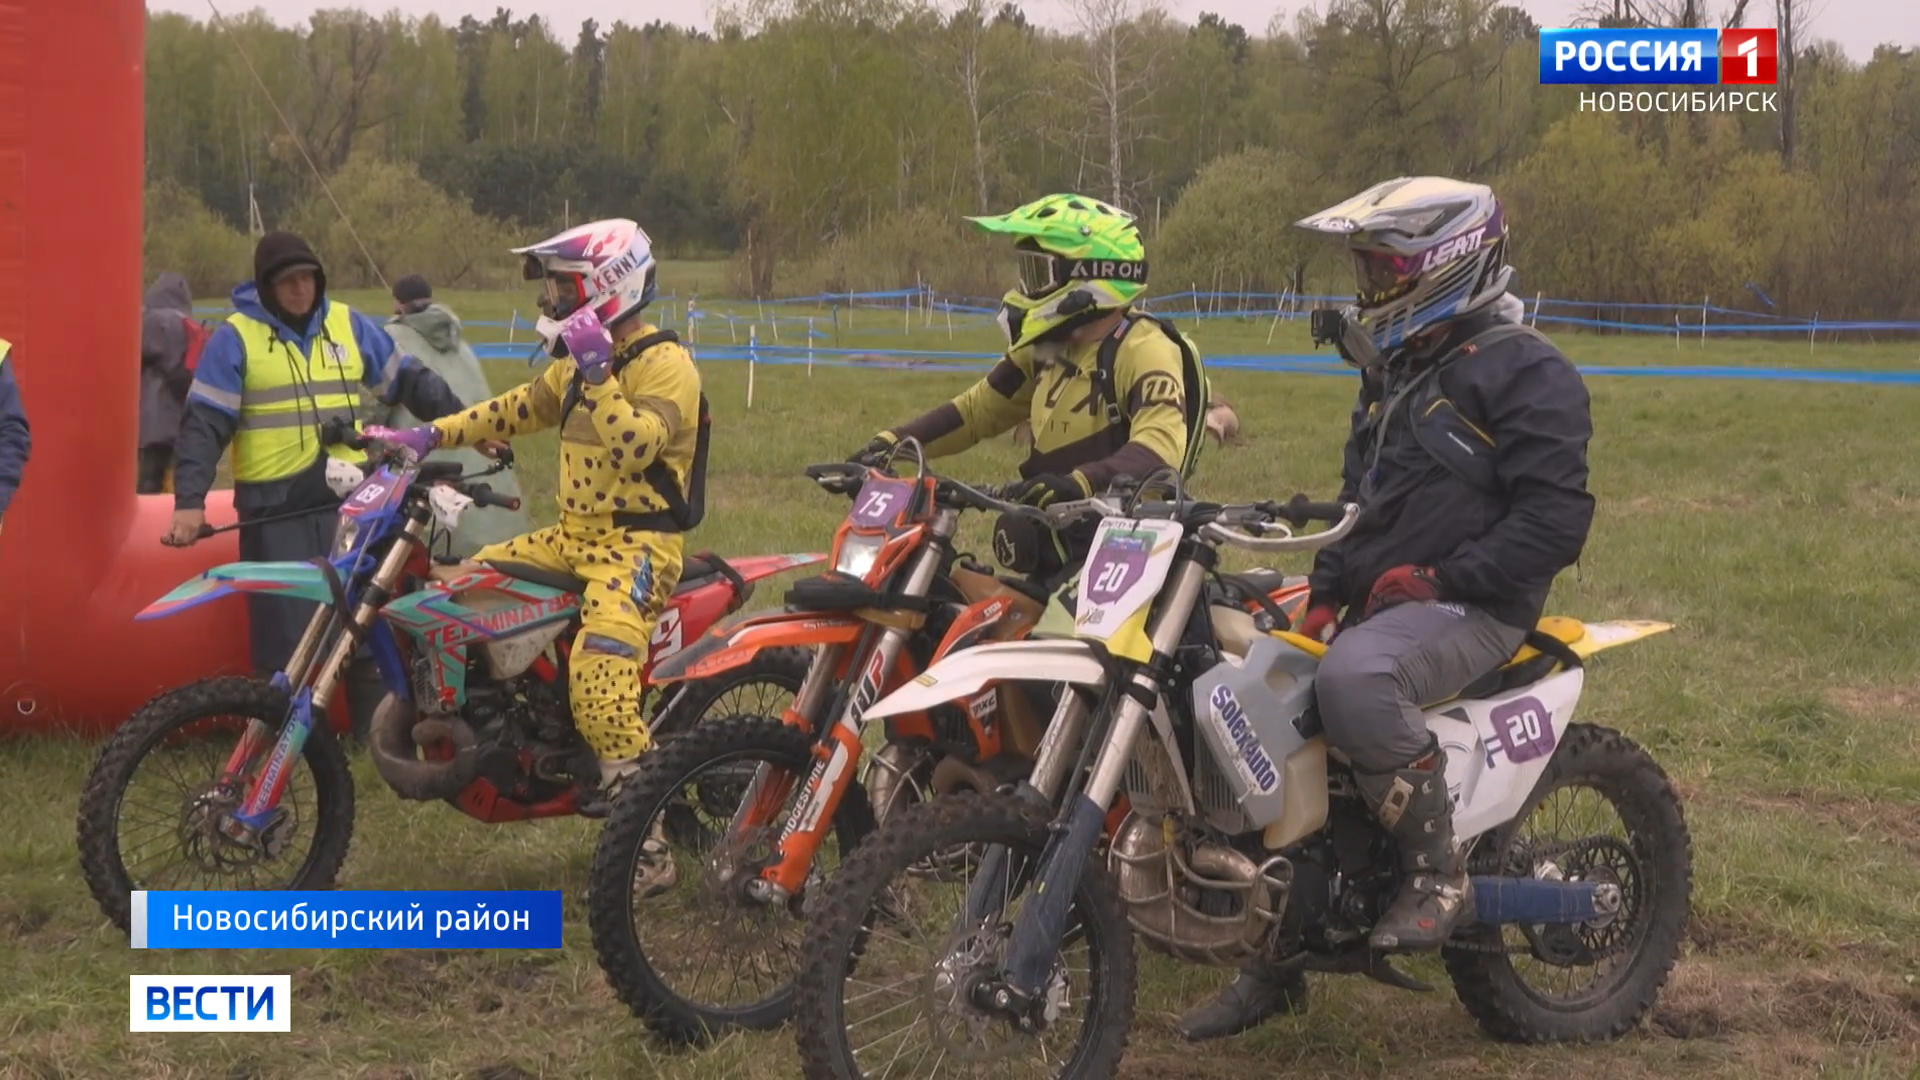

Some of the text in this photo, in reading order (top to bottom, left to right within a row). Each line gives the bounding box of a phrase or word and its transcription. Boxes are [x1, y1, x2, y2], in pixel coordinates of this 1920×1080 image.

[1421, 227, 1487, 272] LEATT
[593, 250, 639, 292] KENNY
[1070, 261, 1143, 279] AIROH
[355, 483, 385, 503] 69
[858, 490, 894, 518] 75
[1093, 561, 1130, 593] 20
[1505, 708, 1542, 748] 20
[777, 759, 826, 856] RIDGESTONE
